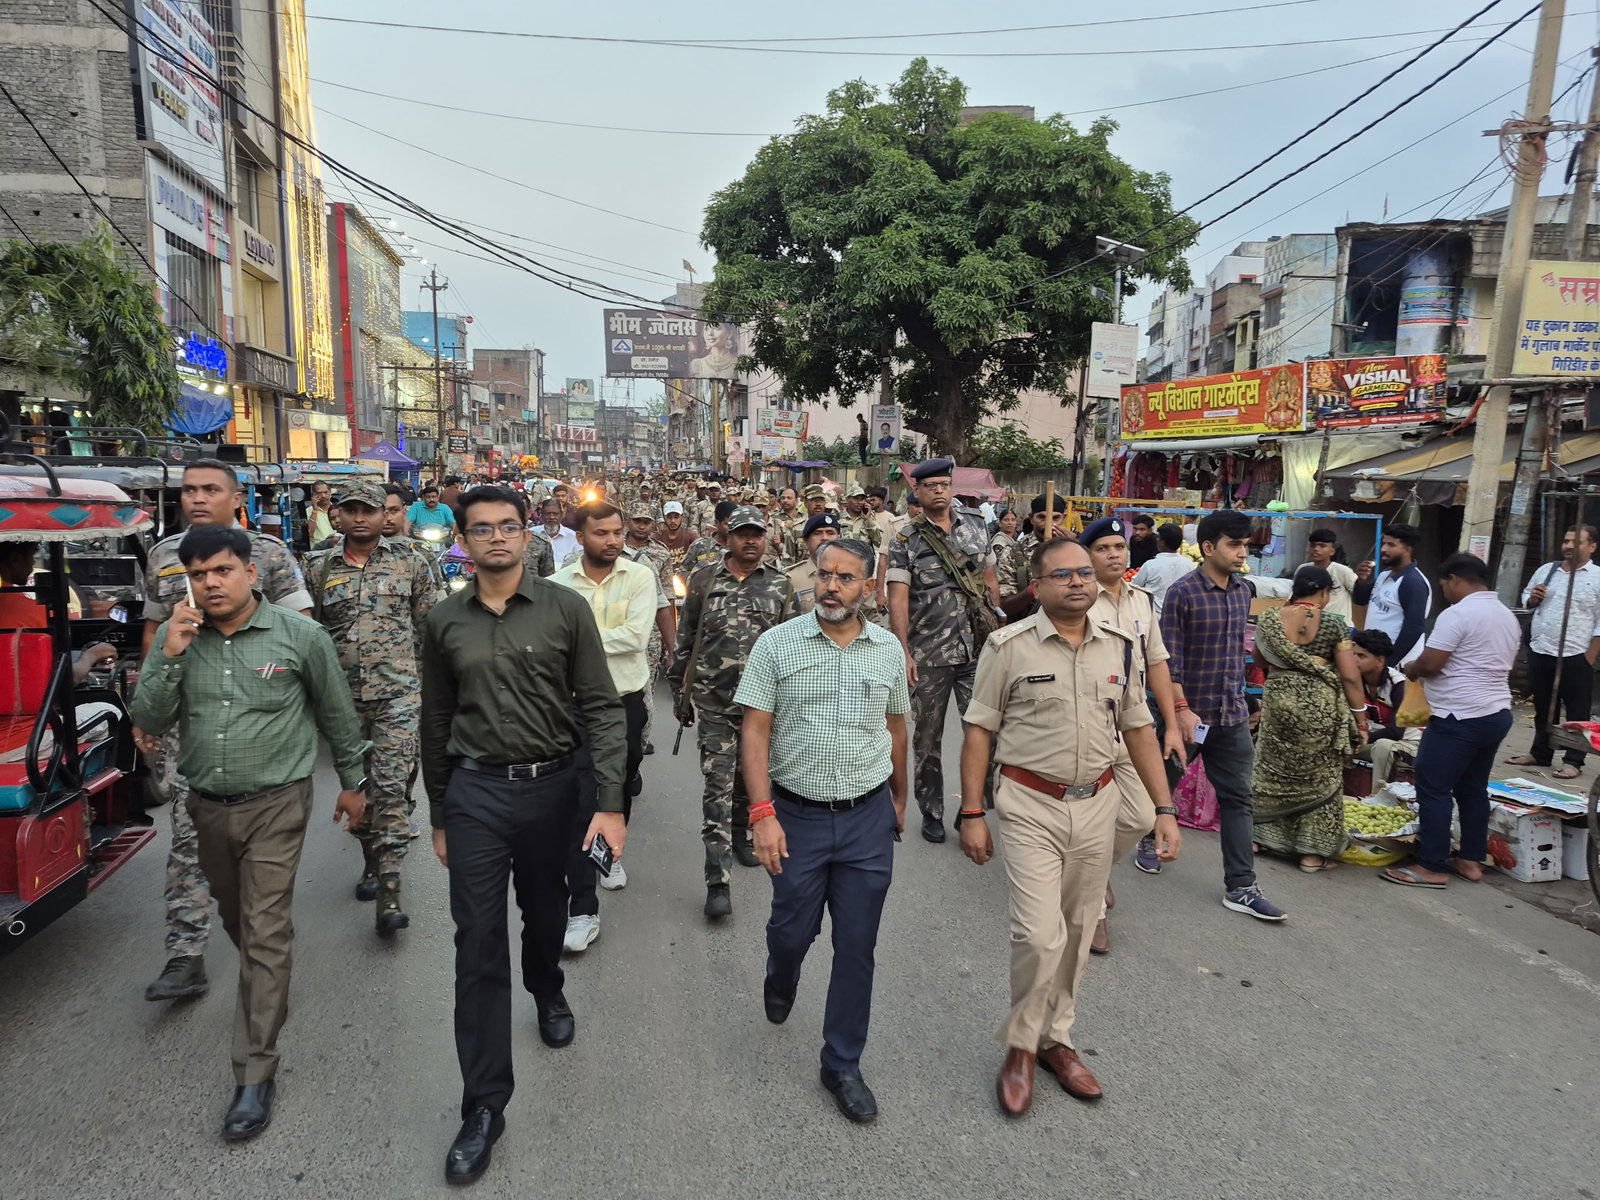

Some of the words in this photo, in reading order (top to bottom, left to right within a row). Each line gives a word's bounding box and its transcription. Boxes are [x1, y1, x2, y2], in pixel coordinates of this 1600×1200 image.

[155, 174, 205, 232] PHILIPS
[609, 311, 642, 335] भीम
[1526, 319, 1541, 331] यह
[1543, 320, 1570, 336] दुकान
[1521, 335, 1531, 350] में
[1532, 339, 1561, 354] गुलाब
[1551, 356, 1589, 371] गिरिडीह
[1342, 369, 1412, 390] VISHAL
[1355, 383, 1401, 395] GARMENTS
[1147, 391, 1167, 421] न्यू
[1165, 383, 1203, 412] विशाल
[1203, 375, 1261, 414] गारमेंट्स
